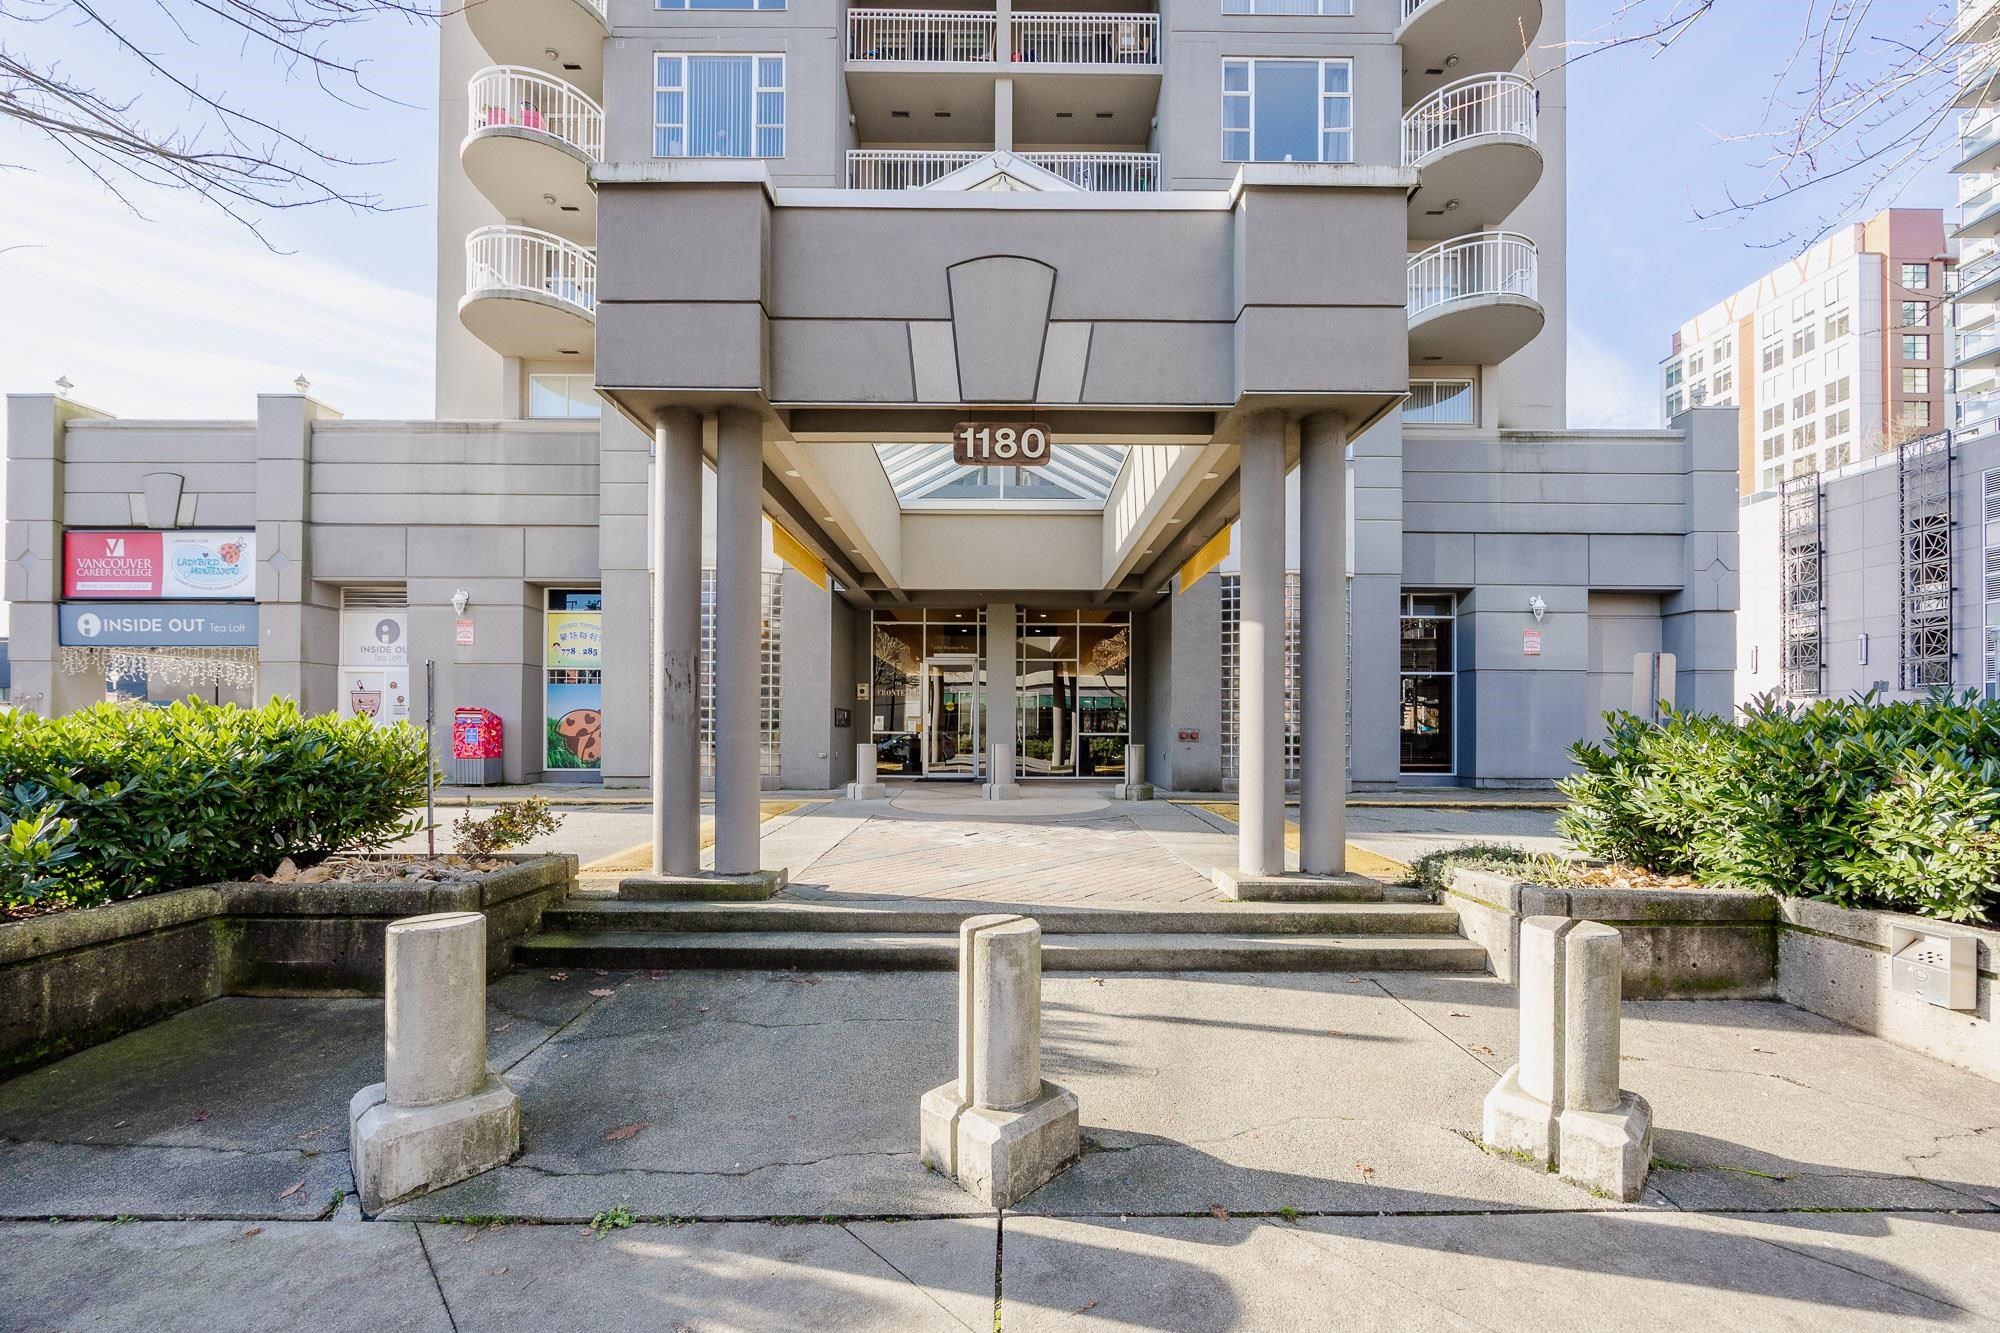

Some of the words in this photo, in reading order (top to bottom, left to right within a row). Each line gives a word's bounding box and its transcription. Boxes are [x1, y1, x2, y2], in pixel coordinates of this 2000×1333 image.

[960, 427, 1046, 459] 1180
[77, 558, 152, 569] VANCOUVER
[76, 568, 112, 577] CAREER
[113, 568, 153, 577] COLLEGE
[103, 618, 162, 632] INSIDE
[168, 618, 205, 632] OUT
[209, 622, 226, 633] Tea
[228, 622, 246, 633] Loft
[360, 645, 392, 654] INSIDE
[395, 645, 408, 654] OU
[561, 647, 577, 657] 778
[582, 647, 598, 657] 285
